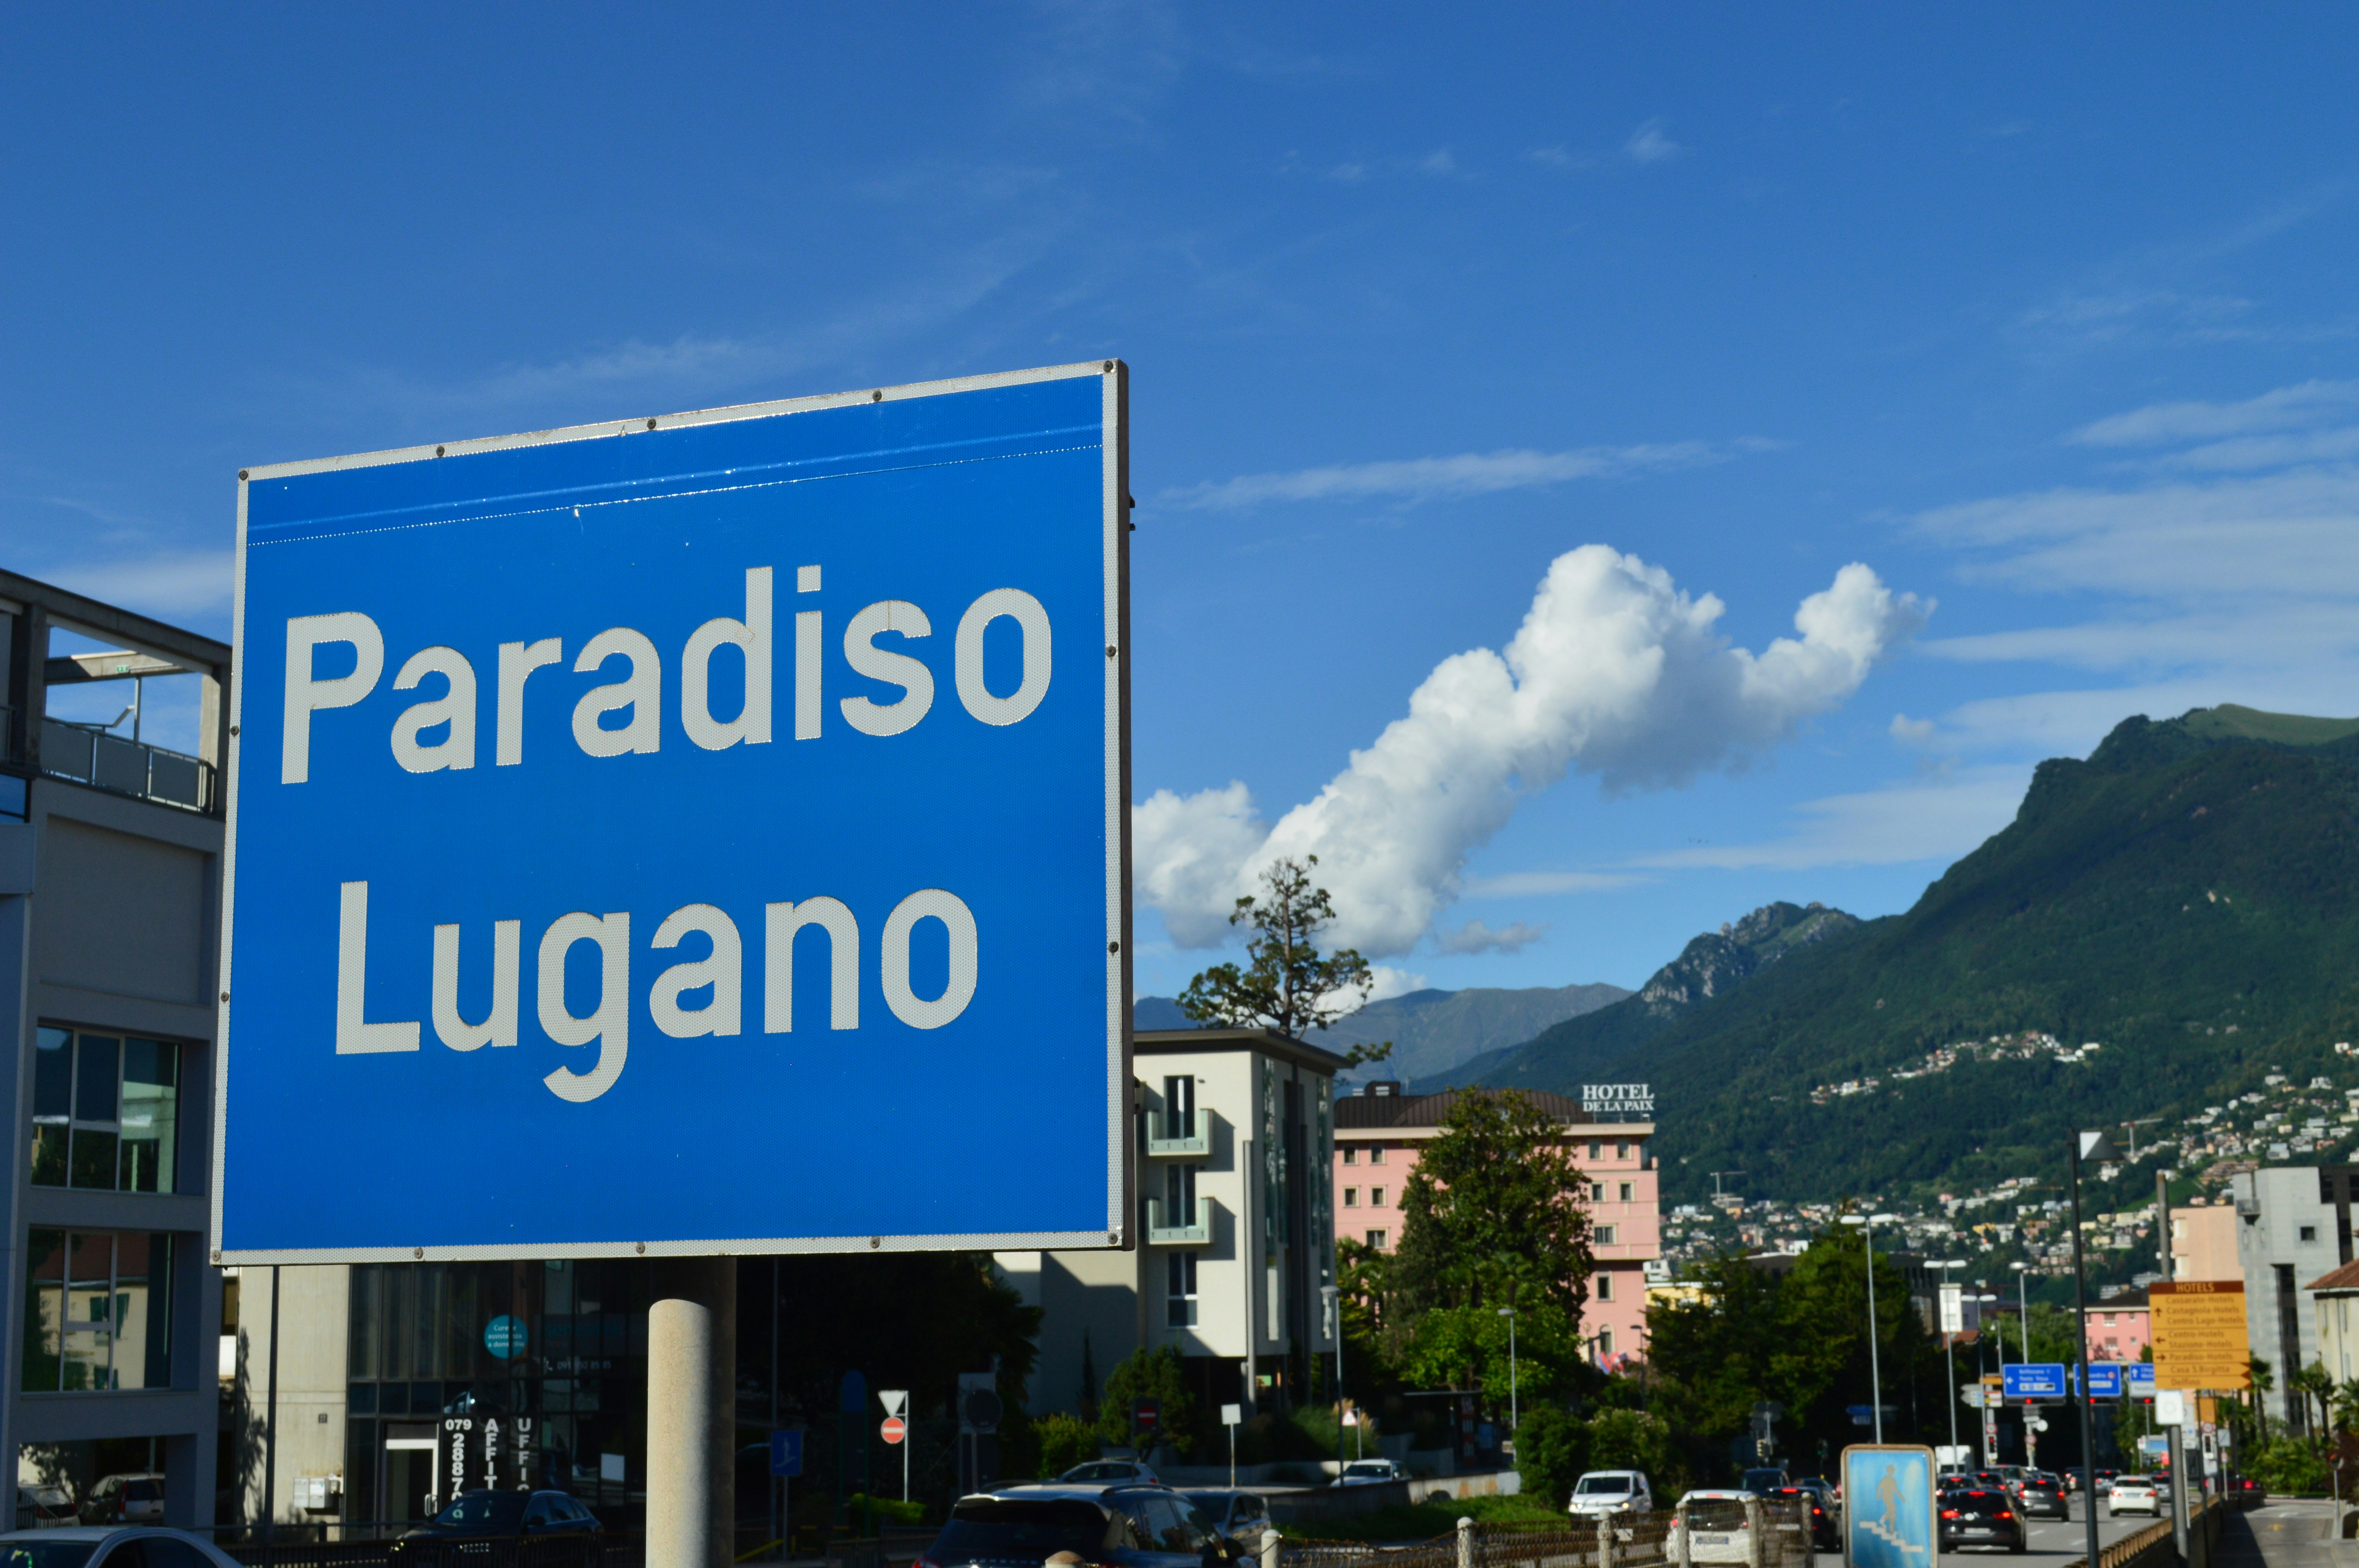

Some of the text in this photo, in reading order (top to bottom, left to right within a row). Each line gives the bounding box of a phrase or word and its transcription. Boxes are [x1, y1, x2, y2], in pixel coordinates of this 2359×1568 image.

[281, 564, 1052, 784] Paradiso
[336, 880, 978, 1103] Lugano
[1583, 1084, 1654, 1100] HOTEL
[1583, 1100, 1654, 1112] DE LA PAIX
[2176, 1282, 2215, 1292] HOTELS
[445, 1419, 472, 1431] 079
